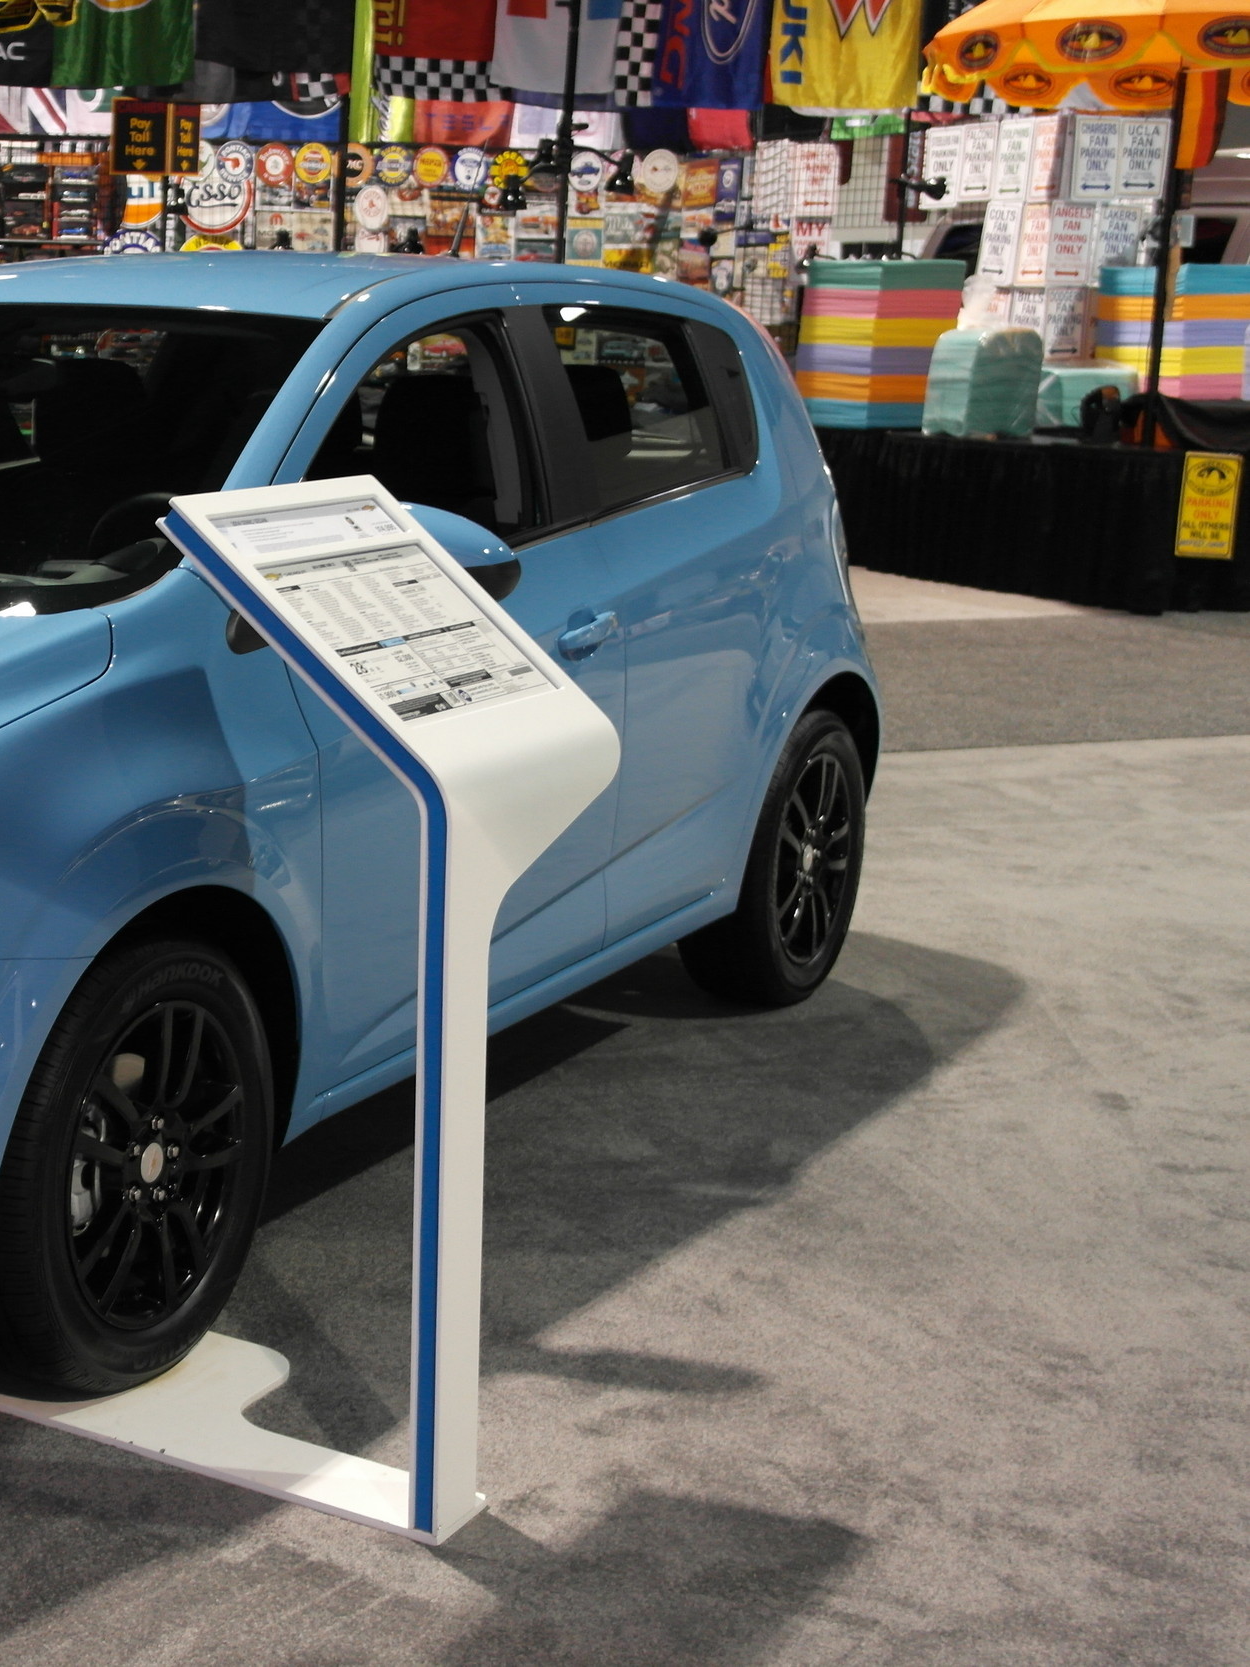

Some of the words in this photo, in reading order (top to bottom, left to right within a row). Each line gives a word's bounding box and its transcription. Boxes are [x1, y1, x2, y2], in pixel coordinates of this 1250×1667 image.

[129, 117, 152, 132] Pay
[179, 119, 193, 132] Pay
[1127, 125, 1160, 136] UCLA
[128, 130, 151, 143] Toll
[1089, 135, 1109, 147] FAN
[1131, 136, 1154, 147] FAN
[971, 138, 987, 150] FAN
[1007, 139, 1022, 151] FAN
[125, 145, 156, 156] Here
[219, 144, 251, 160] PONTIAC
[1080, 147, 1116, 159] PARKING
[1122, 147, 1161, 160] PARKING
[494, 150, 525, 164] USED
[932, 159, 954, 173] ONLY
[1086, 159, 1108, 171] ONLY
[1128, 159, 1153, 171] ONLY
[988, 208, 1017, 222] COLTS
[1054, 206, 1092, 219] ANGELS
[1102, 209, 1137, 221] LAKERS
[796, 222, 826, 237] MY
[993, 220, 1008, 233] FAN
[1031, 219, 1046, 231] FAN
[1062, 219, 1081, 231] FAN
[1108, 220, 1128, 231] FAN
[985, 234, 1012, 245] PARKING
[1053, 233, 1088, 244] PARKING
[1100, 233, 1136, 244] PARKING
[987, 245, 1004, 257] ONLY
[1055, 245, 1083, 255] ONLY
[1021, 302, 1036, 314] FAN
[1055, 302, 1075, 313] FAN
[1014, 315, 1040, 327] PARKING
[1048, 314, 1082, 325] PARKING
[1053, 325, 1075, 337] ONLY
[1185, 496, 1230, 508] PARKING
[1193, 510, 1220, 520] ONLY
[1181, 521, 1196, 529] ALL
[1198, 521, 1230, 531] OTHERS
[1189, 530, 1207, 539] WILL
[1210, 531, 1221, 539] BE
[350, 661, 368, 675] 28
